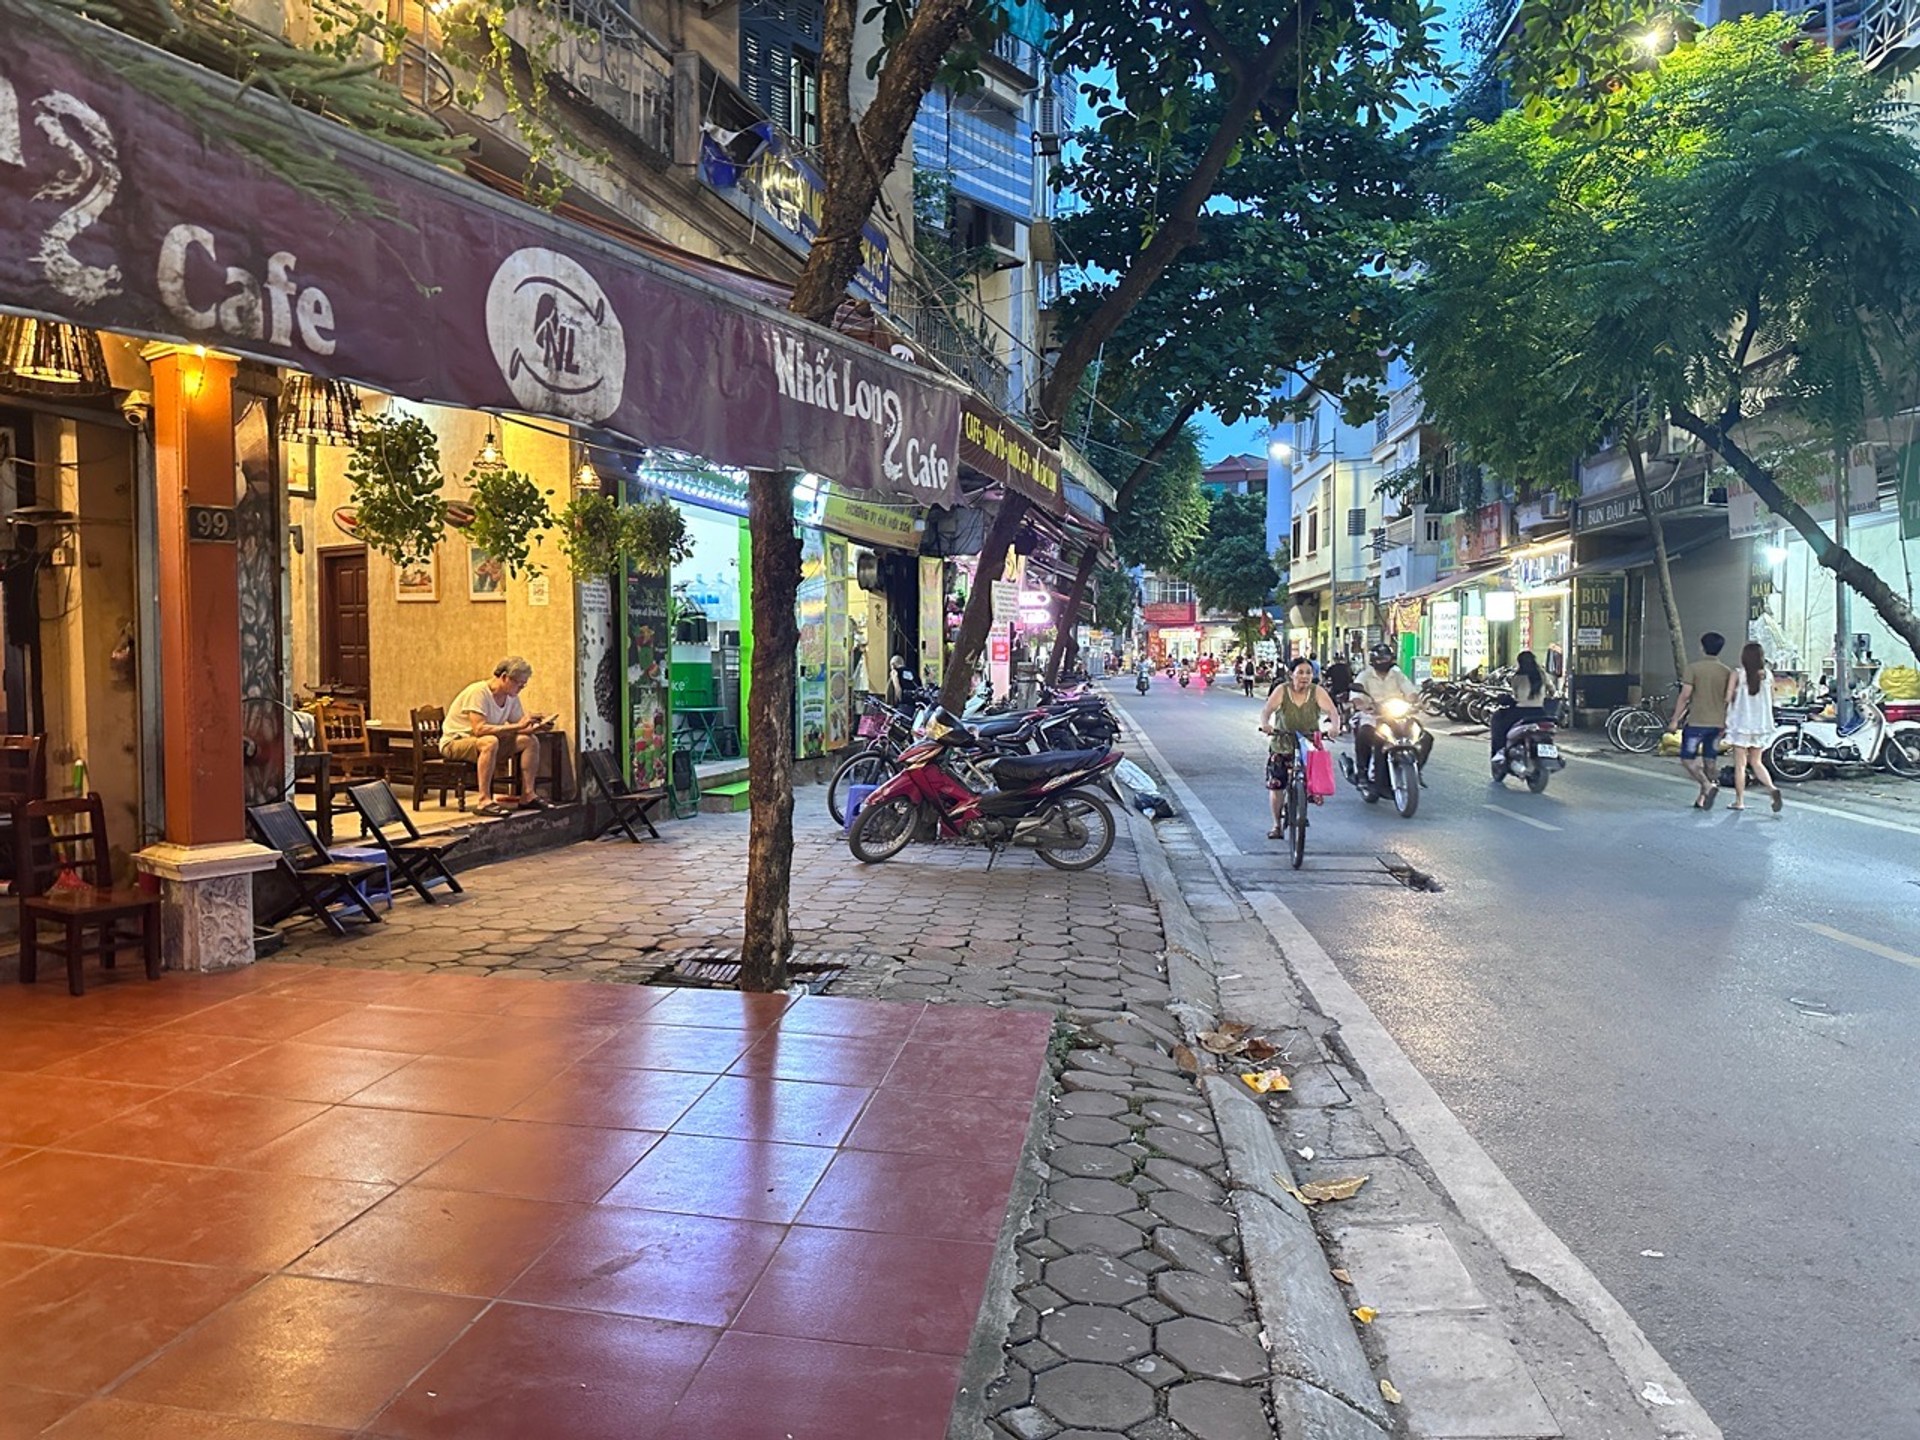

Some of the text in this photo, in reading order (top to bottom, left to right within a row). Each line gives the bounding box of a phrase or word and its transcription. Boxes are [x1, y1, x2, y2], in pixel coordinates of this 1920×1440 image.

[157, 223, 336, 356] Cafe
[773, 331, 839, 413] Nhất
[906, 438, 949, 490] Cafe
[197, 511, 228, 537] 99
[1582, 584, 1610, 604] BÚN
